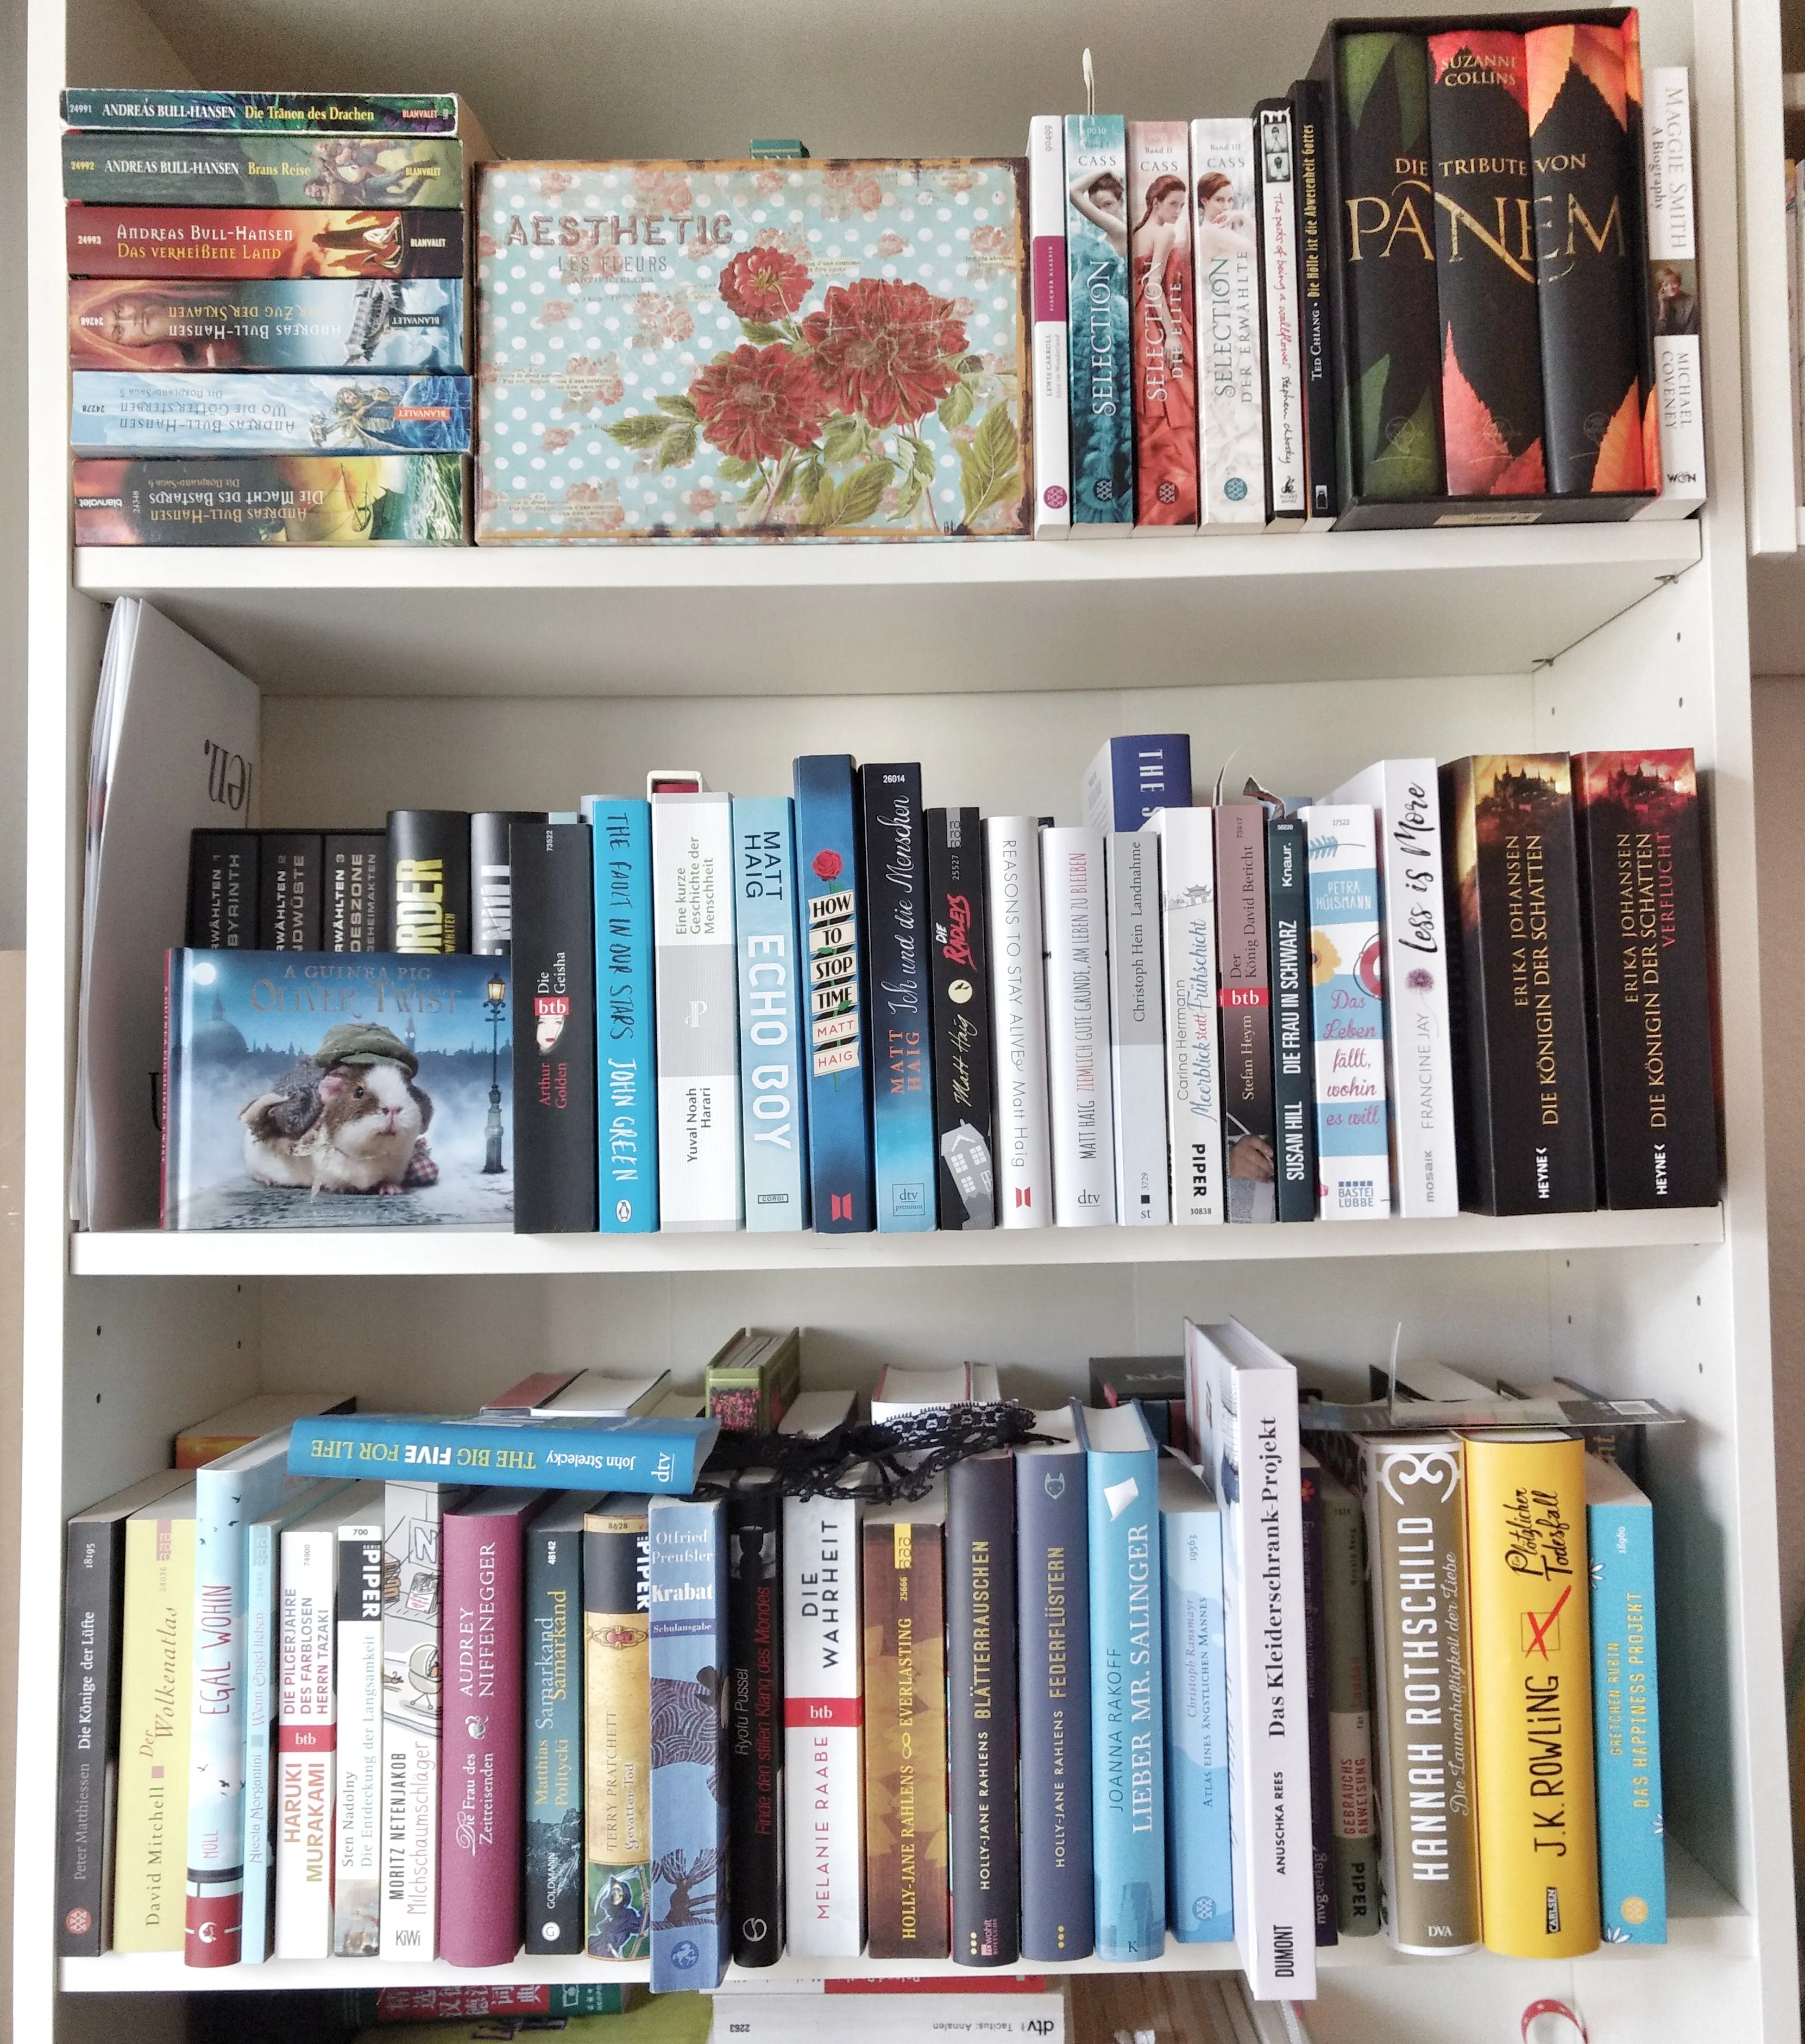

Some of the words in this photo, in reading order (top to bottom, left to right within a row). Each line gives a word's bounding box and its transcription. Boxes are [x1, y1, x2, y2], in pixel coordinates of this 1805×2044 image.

[1439, 54, 1517, 70] SUZANNE
[1444, 70, 1517, 87] COLLINS
[69, 103, 92, 114] 24991
[102, 103, 155, 117] ANDREAS
[156, 104, 236, 118] BULL-HANSEN
[245, 106, 264, 118] Die
[267, 106, 304, 120] Tränen
[307, 107, 325, 121] des
[329, 107, 374, 121] Drachen
[402, 110, 438, 118] BLANVALET
[1665, 86, 1684, 172] MAGGIE
[1078, 154, 1116, 167] CASS
[1140, 160, 1179, 172] CASS
[1206, 156, 1246, 169] CASS
[1393, 156, 1427, 177] DIE
[1437, 156, 1527, 179] TRIBUTE
[1533, 153, 1586, 174] VON
[505, 213, 735, 247] AESTHETIC
[1344, 190, 1627, 281] PANEM
[1669, 185, 1687, 248] SMITH
[78, 234, 102, 244] 24993
[558, 256, 592, 272] LES
[602, 255, 668, 273] FLEURS
[1169, 283, 1184, 335] ELITE
[1235, 253, 1251, 355] ERWÄHLTE
[1085, 260, 1117, 418] SELECTION
[1140, 260, 1168, 402] SELECTION
[1207, 258, 1237, 399] SELECTION
[1171, 348, 1184, 379] DIE
[1240, 368, 1253, 404] DER
[396, 408, 447, 419] BLANVALET
[79, 497, 123, 509] blanvalet
[883, 774, 905, 783] 26014
[546, 829, 554, 852] 73522
[605, 812, 630, 850] THE
[690, 837, 700, 860] der
[608, 862, 633, 908] FAULT
[676, 868, 688, 902] kurze
[745, 833, 764, 899] HAIG
[763, 830, 784, 901] MATT
[1068, 853, 1087, 895] BLEIBEN
[1127, 842, 1143, 918] Landnahme
[1238, 847, 1255, 894] Bericht
[1280, 843, 1295, 889] Knaur.
[688, 864, 701, 935] Geschichte
[704, 858, 716, 935] Menschheit
[1070, 898, 1087, 912] ZU
[1524, 836, 1548, 942] SCHATTEN
[1656, 832, 1677, 949] VERFLUCHT
[609, 917, 633, 939] IN
[676, 915, 688, 935] Eine
[934, 922, 948, 945] DIE
[941, 894, 972, 965] RADLEYS
[1070, 914, 1089, 946] LEBEN
[1241, 897, 1256, 937] David
[610, 942, 634, 974] OUR
[1072, 948, 1090, 964] AM
[1129, 924, 1144, 956] Hein
[1242, 940, 1261, 980] König
[1278, 920, 1299, 992] SCHWARZ
[282, 965, 297, 979] A
[305, 965, 389, 979] GUINEA
[396, 967, 431, 980] PIG
[537, 971, 551, 994] Die
[553, 951, 568, 994] Geisha
[1229, 954, 1243, 980] Der
[1531, 947, 1551, 987] DER
[747, 933, 789, 1046] ECHO
[1071, 965, 1092, 1013] GRÜNDE,
[1130, 958, 1148, 1024] Christoph
[1281, 994, 1299, 1010] IN
[609, 985, 636, 1041] STARS
[1074, 1016, 1093, 1042] GUTE
[1173, 980, 1187, 1050] Herrmann
[1281, 1013, 1300, 1051] FRAU
[1238, 1015, 1255, 1056] Heym
[1532, 994, 1556, 1086] KÖNIGIN
[607, 1057, 638, 1107] JOHN
[888, 1029, 907, 1095] MATT
[904, 1031, 923, 1092] HAIG
[1075, 1045, 1095, 1093] ZIEMLICH
[1175, 1054, 1189, 1102] Carina
[1240, 1058, 1256, 1102] Stefan
[1282, 1052, 1301, 1076] DIE
[686, 1088, 699, 1123] Noah
[701, 1087, 713, 1128] Harari
[751, 1063, 791, 1150] BOY
[1077, 1100, 1096, 1129] HAIG
[1284, 1101, 1304, 1131] HILL
[1540, 1092, 1560, 1126] DIE
[610, 1114, 639, 1182] GREEN
[687, 1127, 699, 1163] Yuval
[1078, 1132, 1097, 1161] MATT
[1285, 1133, 1306, 1182] SUSAN
[1139, 1173, 1149, 1192] 3729
[1188, 1208, 1212, 1216] 30838
[311, 1439, 355, 1459] LIFE
[359, 1442, 400, 1462] FOR
[405, 1444, 452, 1464] FIVE
[456, 1447, 492, 1468] BIG
[496, 1449, 536, 1471] THE
[546, 1449, 603, 1469] Strelecky
[606, 1454, 637, 1471] John
[351, 1528, 369, 1537] 700
[546, 1541, 557, 1566] 48142
[1256, 1416, 1286, 1691] Kleiderschrank-Projekt
[84, 1544, 96, 1569] 18195
[303, 1544, 311, 1568] 74900
[650, 1582, 715, 1603] Krabat
[800, 1573, 819, 1619] DIE
[820, 1520, 840, 1671] WAHRHEIT
[900, 1577, 909, 1603] 25666
[282, 1589, 297, 1686] PILGERJAHRE
[300, 1597, 313, 1683] FARBLOSEN
[316, 1609, 329, 1660] TAZAKI
[478, 1542, 496, 1698] NIFFENEGGER
[968, 1541, 992, 1721] BLÄTTERRAUSCHEN
[1397, 1517, 1444, 1726] ROTHSCHILD
[1625, 1592, 1645, 1667] PROJEKT
[458, 1608, 475, 1698] AUDREY
[896, 1617, 914, 1728] EVERLASTING
[282, 1691, 297, 1716] DIE
[300, 1687, 313, 1716] DES
[316, 1664, 329, 1716] HERRN
[734, 1668, 750, 1713] Pussel
[1104, 1647, 1123, 1722] RAKOFF
[734, 1715, 752, 1755] Ryofu
[1266, 1697, 1286, 1740] Das
[1628, 1674, 1649, 1770] HAPPINESS
[533, 1740, 550, 1807] Matthias
[812, 1738, 829, 1812] RAABE
[977, 1732, 990, 1797] RAHLENS
[1106, 1729, 1125, 1813] JOANNA
[283, 1763, 303, 1845] HARUKI
[389, 1753, 407, 1842] NETENJAKOB
[478, 1753, 495, 1846] Zeitreisenden
[898, 1765, 916, 1839] RAHLENS
[1273, 1772, 1285, 1802] REES
[1631, 1776, 1650, 1809] DAS
[147, 1787, 165, 1866] Mitchell
[305, 1763, 326, 1884] MURAKAMI
[1406, 1744, 1450, 1882] HANNAH
[978, 1804, 991, 1891] HOLLY-JANE
[1274, 1805, 1287, 1876] ANUSCHKA
[387, 1848, 405, 1902] MORITZ
[546, 1853, 556, 1910] GOLDMANN
[813, 1822, 831, 1921] MELANIE
[900, 1844, 917, 1941] HOLLY-JANE
[144, 1873, 162, 1928] David
[1272, 1924, 1297, 1979] DUMONT
[730, 2023, 751, 2033] 2263
[933, 2022, 973, 2032] Annalen
[977, 2023, 1014, 2032] Tacitus:
[1028, 2020, 1055, 2036] dtv
